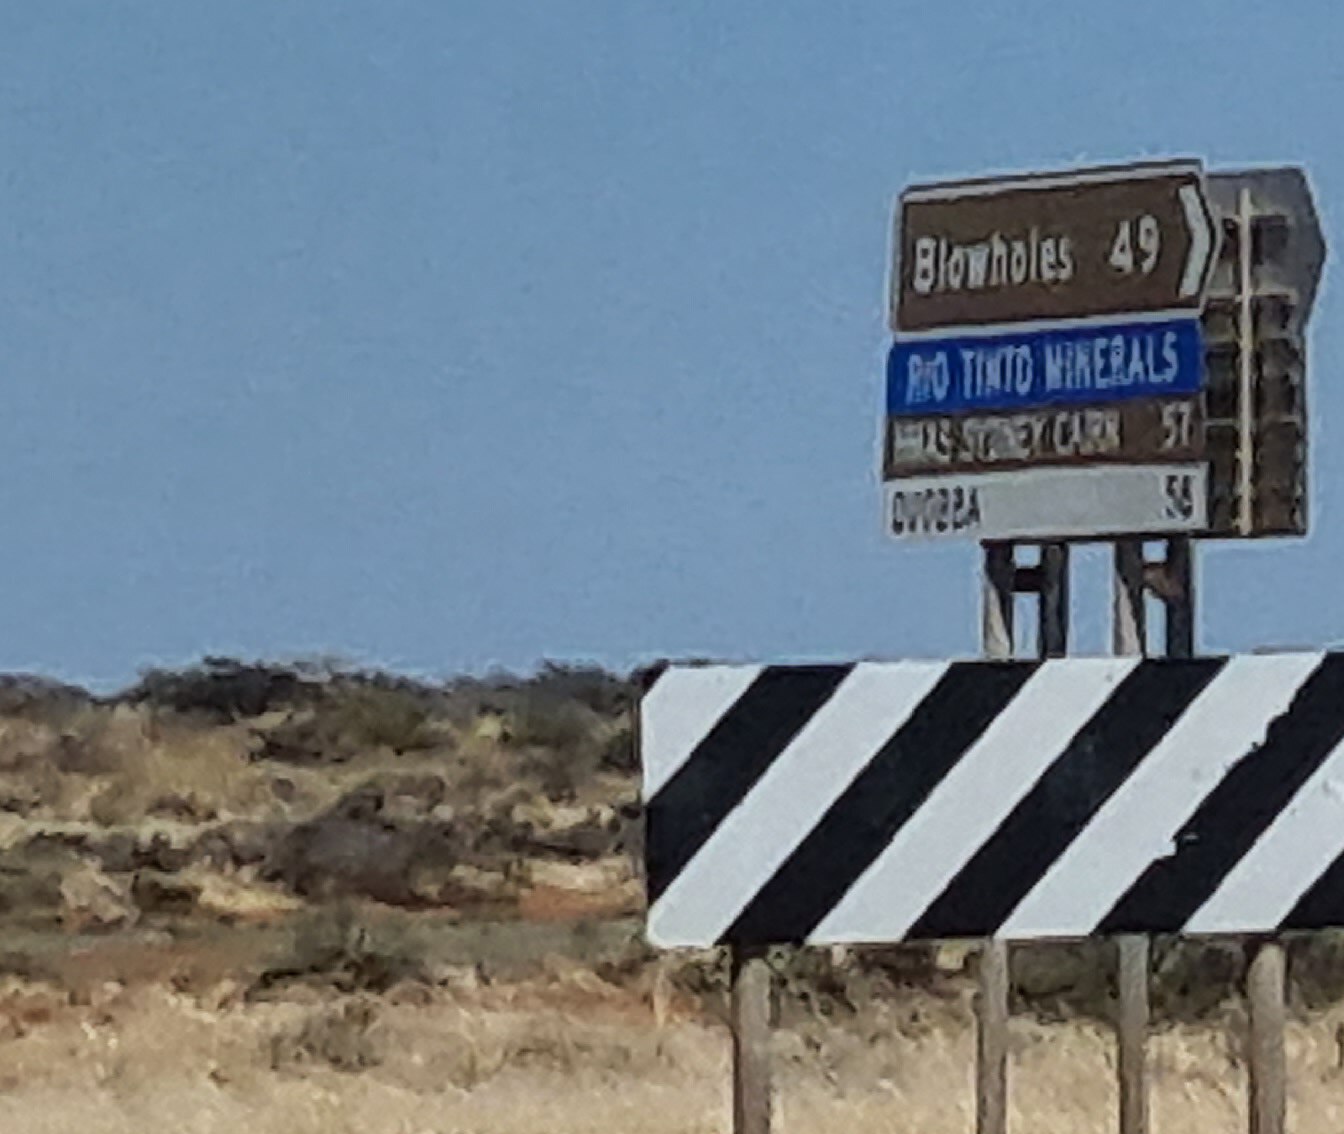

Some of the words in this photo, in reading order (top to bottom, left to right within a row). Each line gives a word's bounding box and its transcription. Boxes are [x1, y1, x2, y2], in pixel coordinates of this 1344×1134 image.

[913, 226, 1076, 293] Blowholes
[1109, 213, 1163, 274] 49
[960, 343, 1034, 399] TINTO
[1044, 330, 1179, 393] MINERALS
